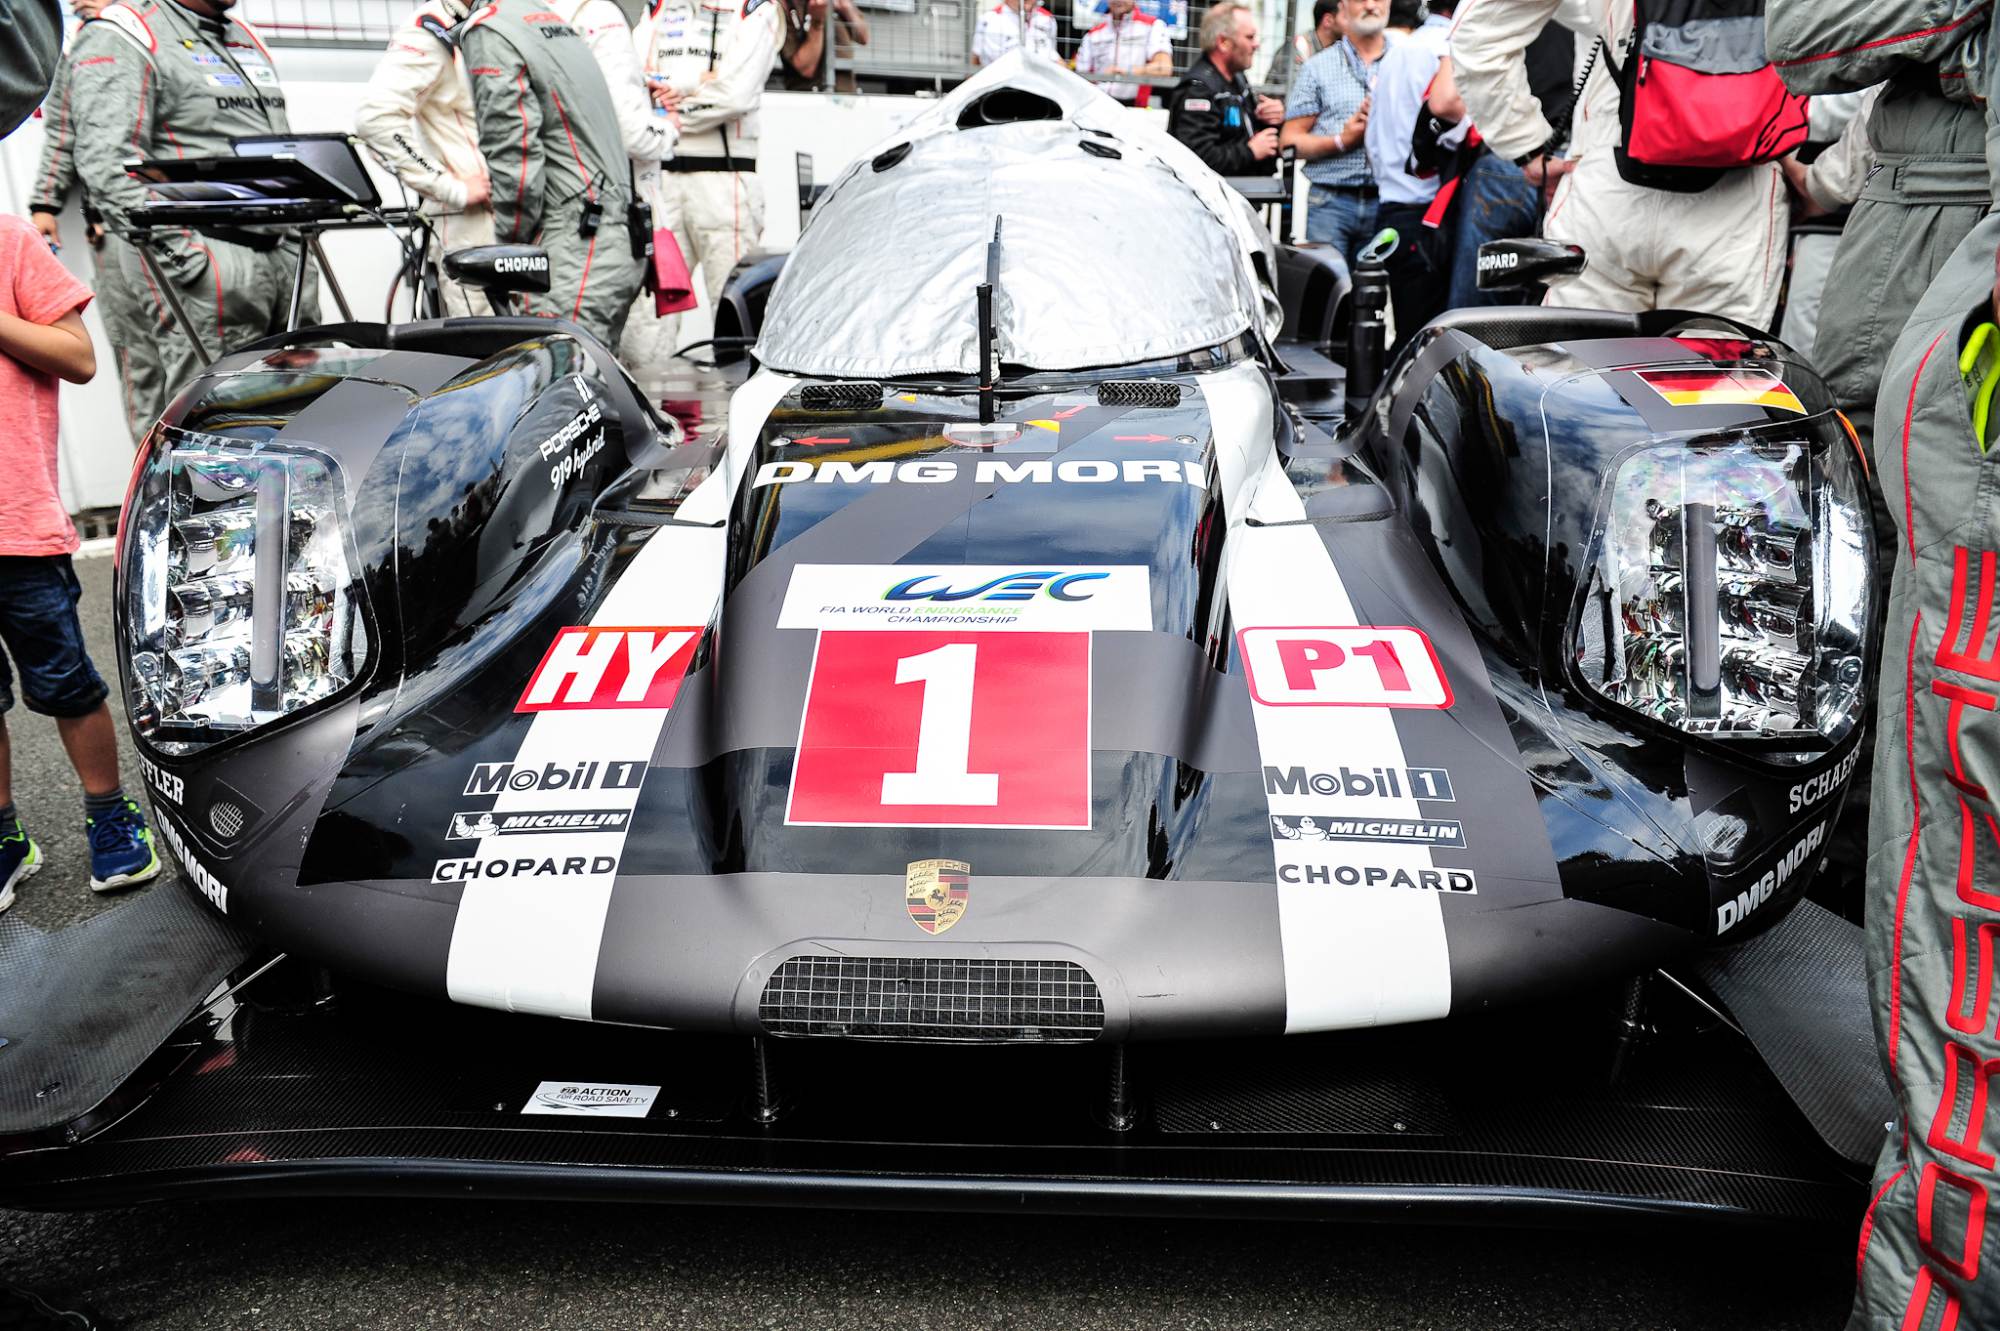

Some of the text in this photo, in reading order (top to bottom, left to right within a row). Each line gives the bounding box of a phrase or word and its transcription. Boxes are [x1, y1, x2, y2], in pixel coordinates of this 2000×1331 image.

[494, 256, 549, 273] CHOPARD
[539, 403, 602, 461] PORSCHE
[551, 426, 606, 490] 919 hybrid
[752, 460, 1207, 491] DMG MORI
[881, 571, 1111, 602] WEC
[819, 605, 1024, 615] FIA WORLD ENDURANCE
[887, 615, 1018, 624] CHAMPIONSHIP
[525, 631, 698, 705] HY
[1276, 640, 1412, 692] P1
[880, 643, 999, 806] 1
[138, 751, 184, 806] FFLER
[466, 761, 599, 793] Mobil
[1263, 766, 1402, 798] Mobil
[502, 813, 628, 828] MICHELIN
[1329, 821, 1458, 839] MICHELIN
[154, 804, 228, 914] DMG MORI
[435, 856, 616, 881] CHOPARD
[909, 861, 970, 873] PORSCHE
[1278, 864, 1474, 892] CHOPARD
[1717, 819, 1827, 936] DMG MORI
[573, 1094, 603, 1102] ROAD
[605, 1096, 648, 1104] SAFETY
[581, 1087, 631, 1096] ACTION
